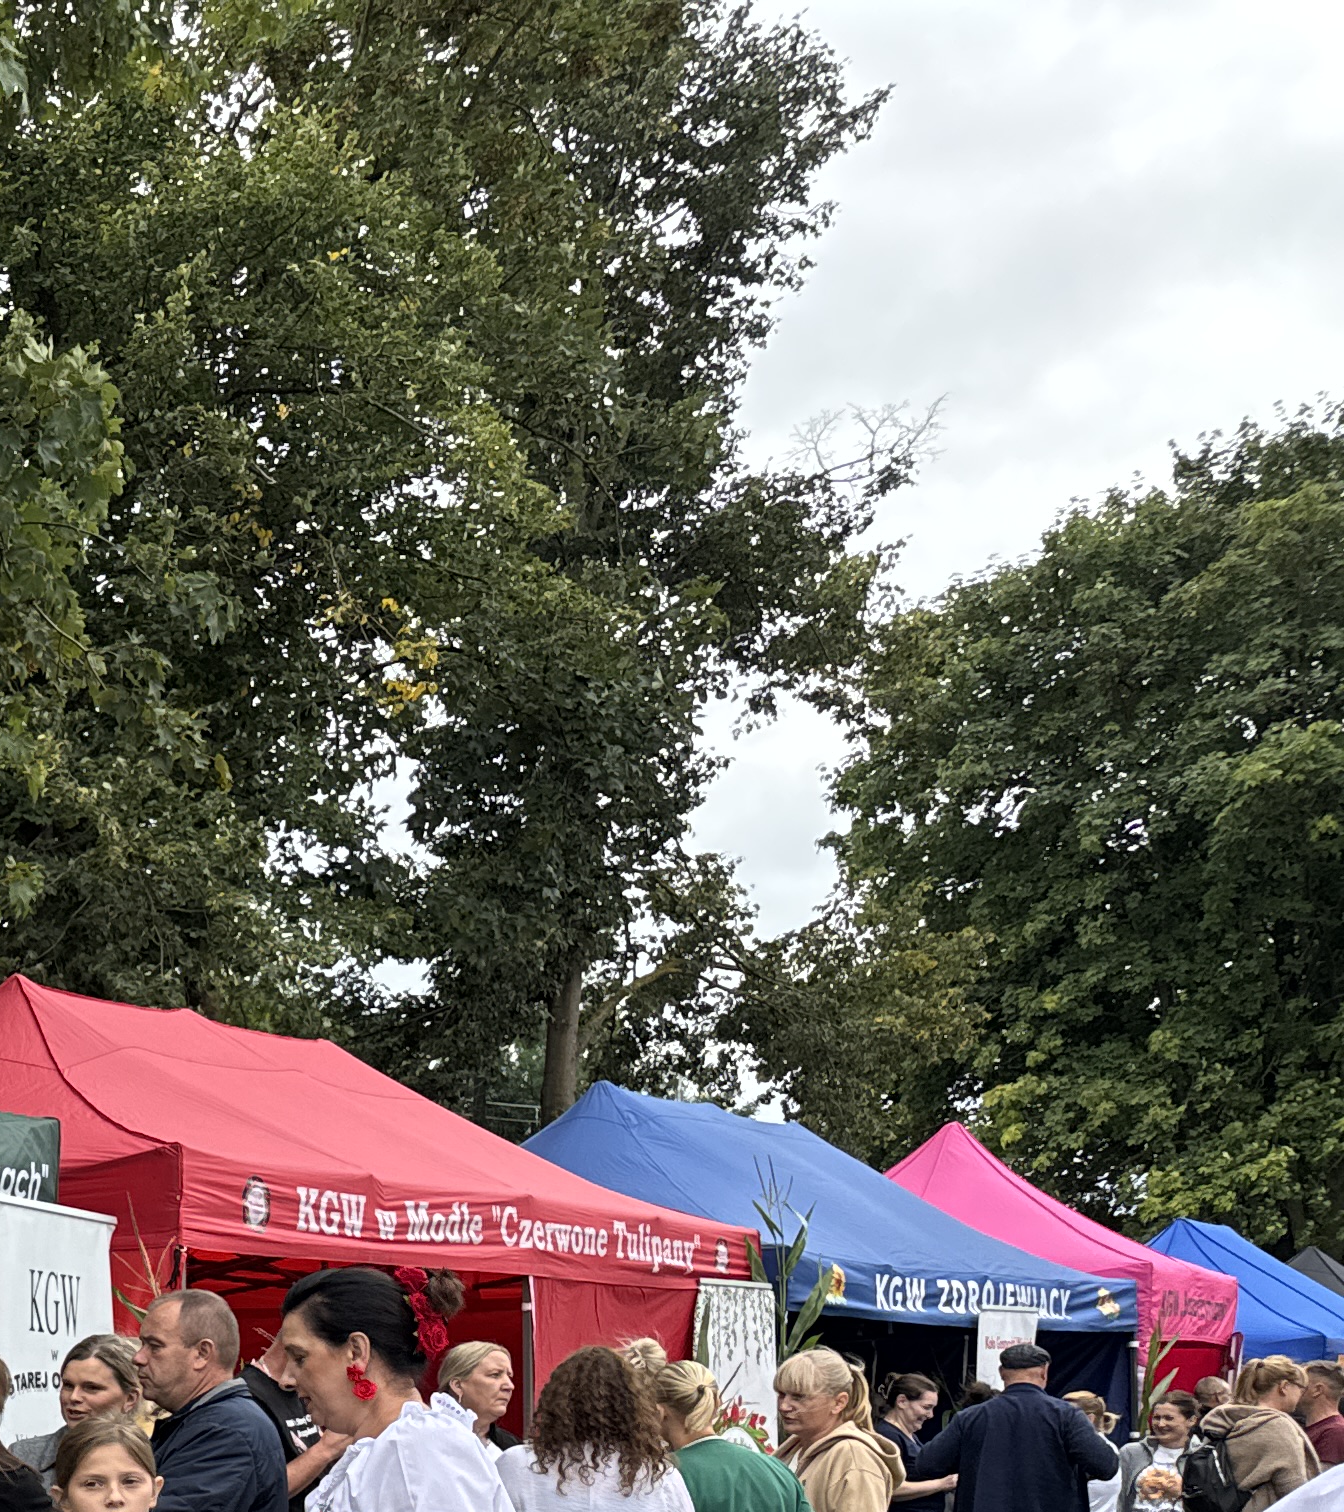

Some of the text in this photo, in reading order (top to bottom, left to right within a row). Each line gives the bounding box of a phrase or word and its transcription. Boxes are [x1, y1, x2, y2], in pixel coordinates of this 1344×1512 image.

[296, 1187, 702, 1275] KGW w Modle "Czerwone Tulipany"
[29, 1269, 80, 1337] KGW
[875, 1273, 927, 1313] KGW
